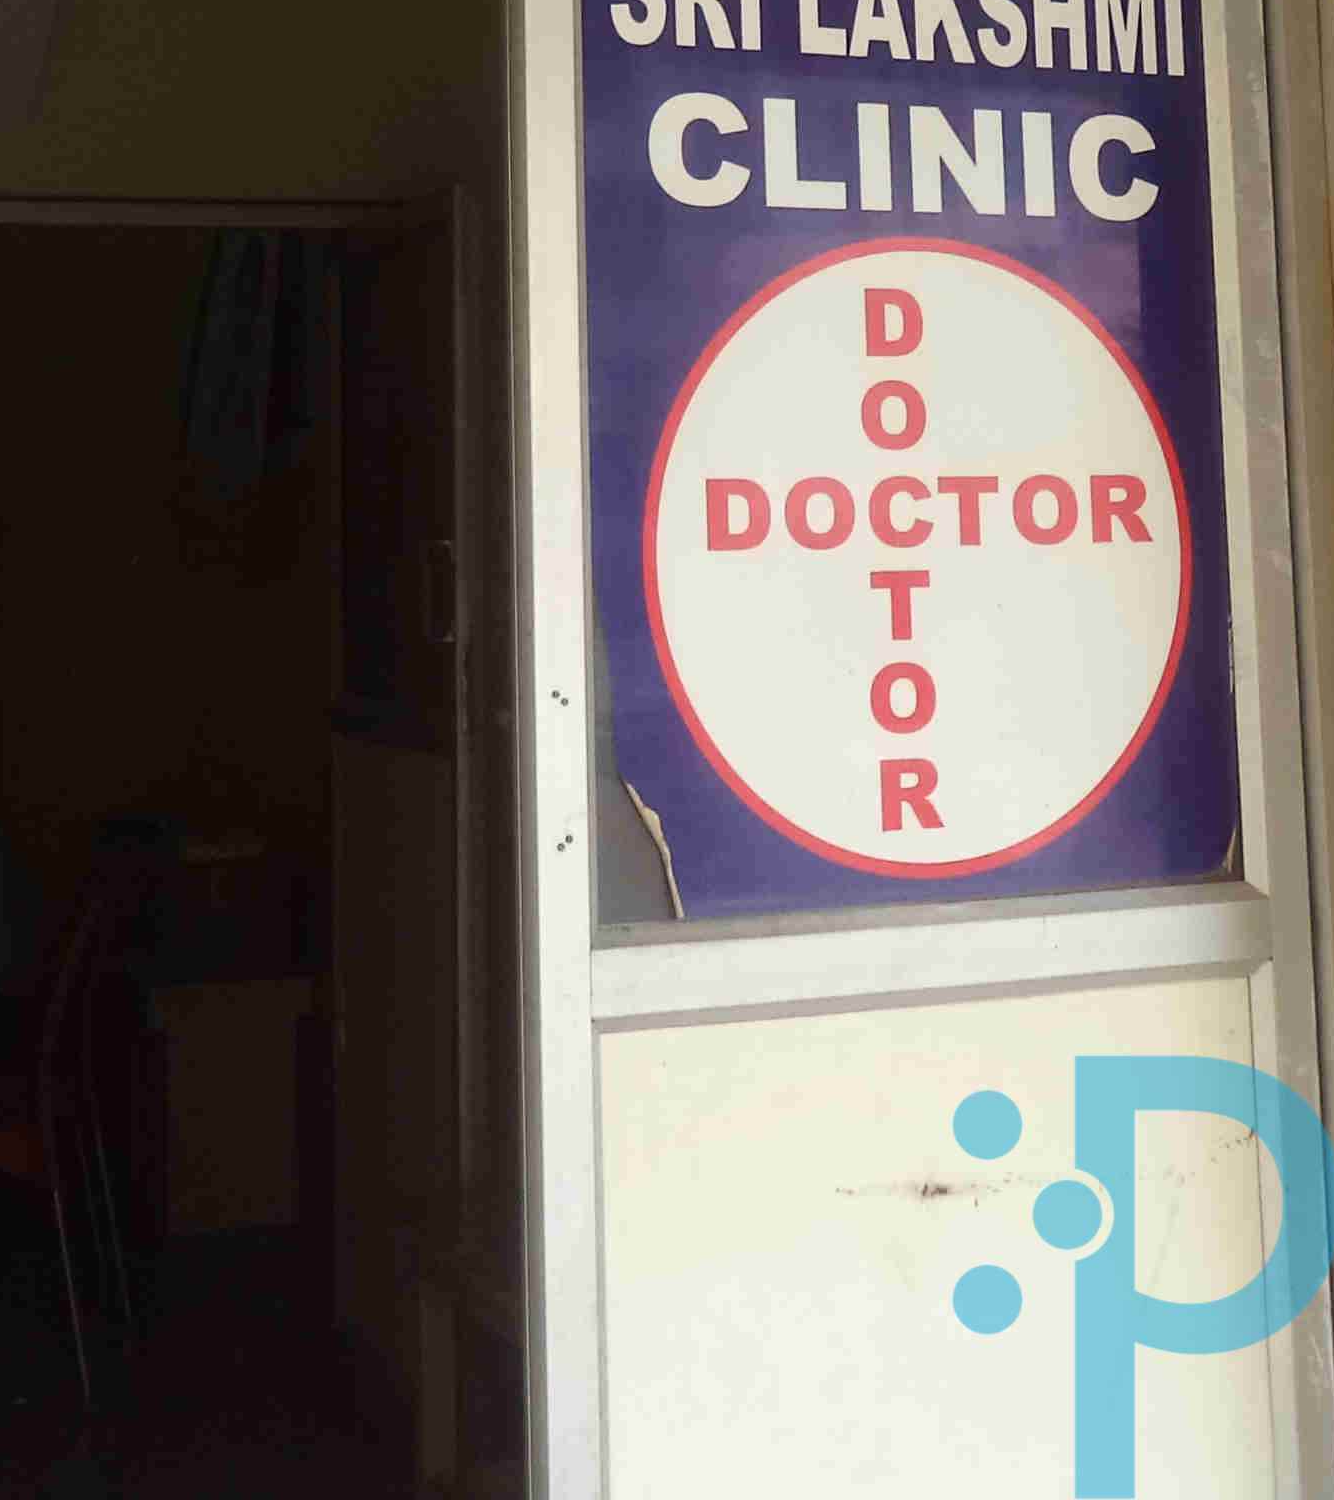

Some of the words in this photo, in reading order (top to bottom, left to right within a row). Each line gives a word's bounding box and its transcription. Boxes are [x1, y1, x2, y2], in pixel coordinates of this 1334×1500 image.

[647, 91, 1160, 222] CLINIC
[704, 473, 1154, 553] DOCTOR
[860, 287, 946, 832] DOCTOR
